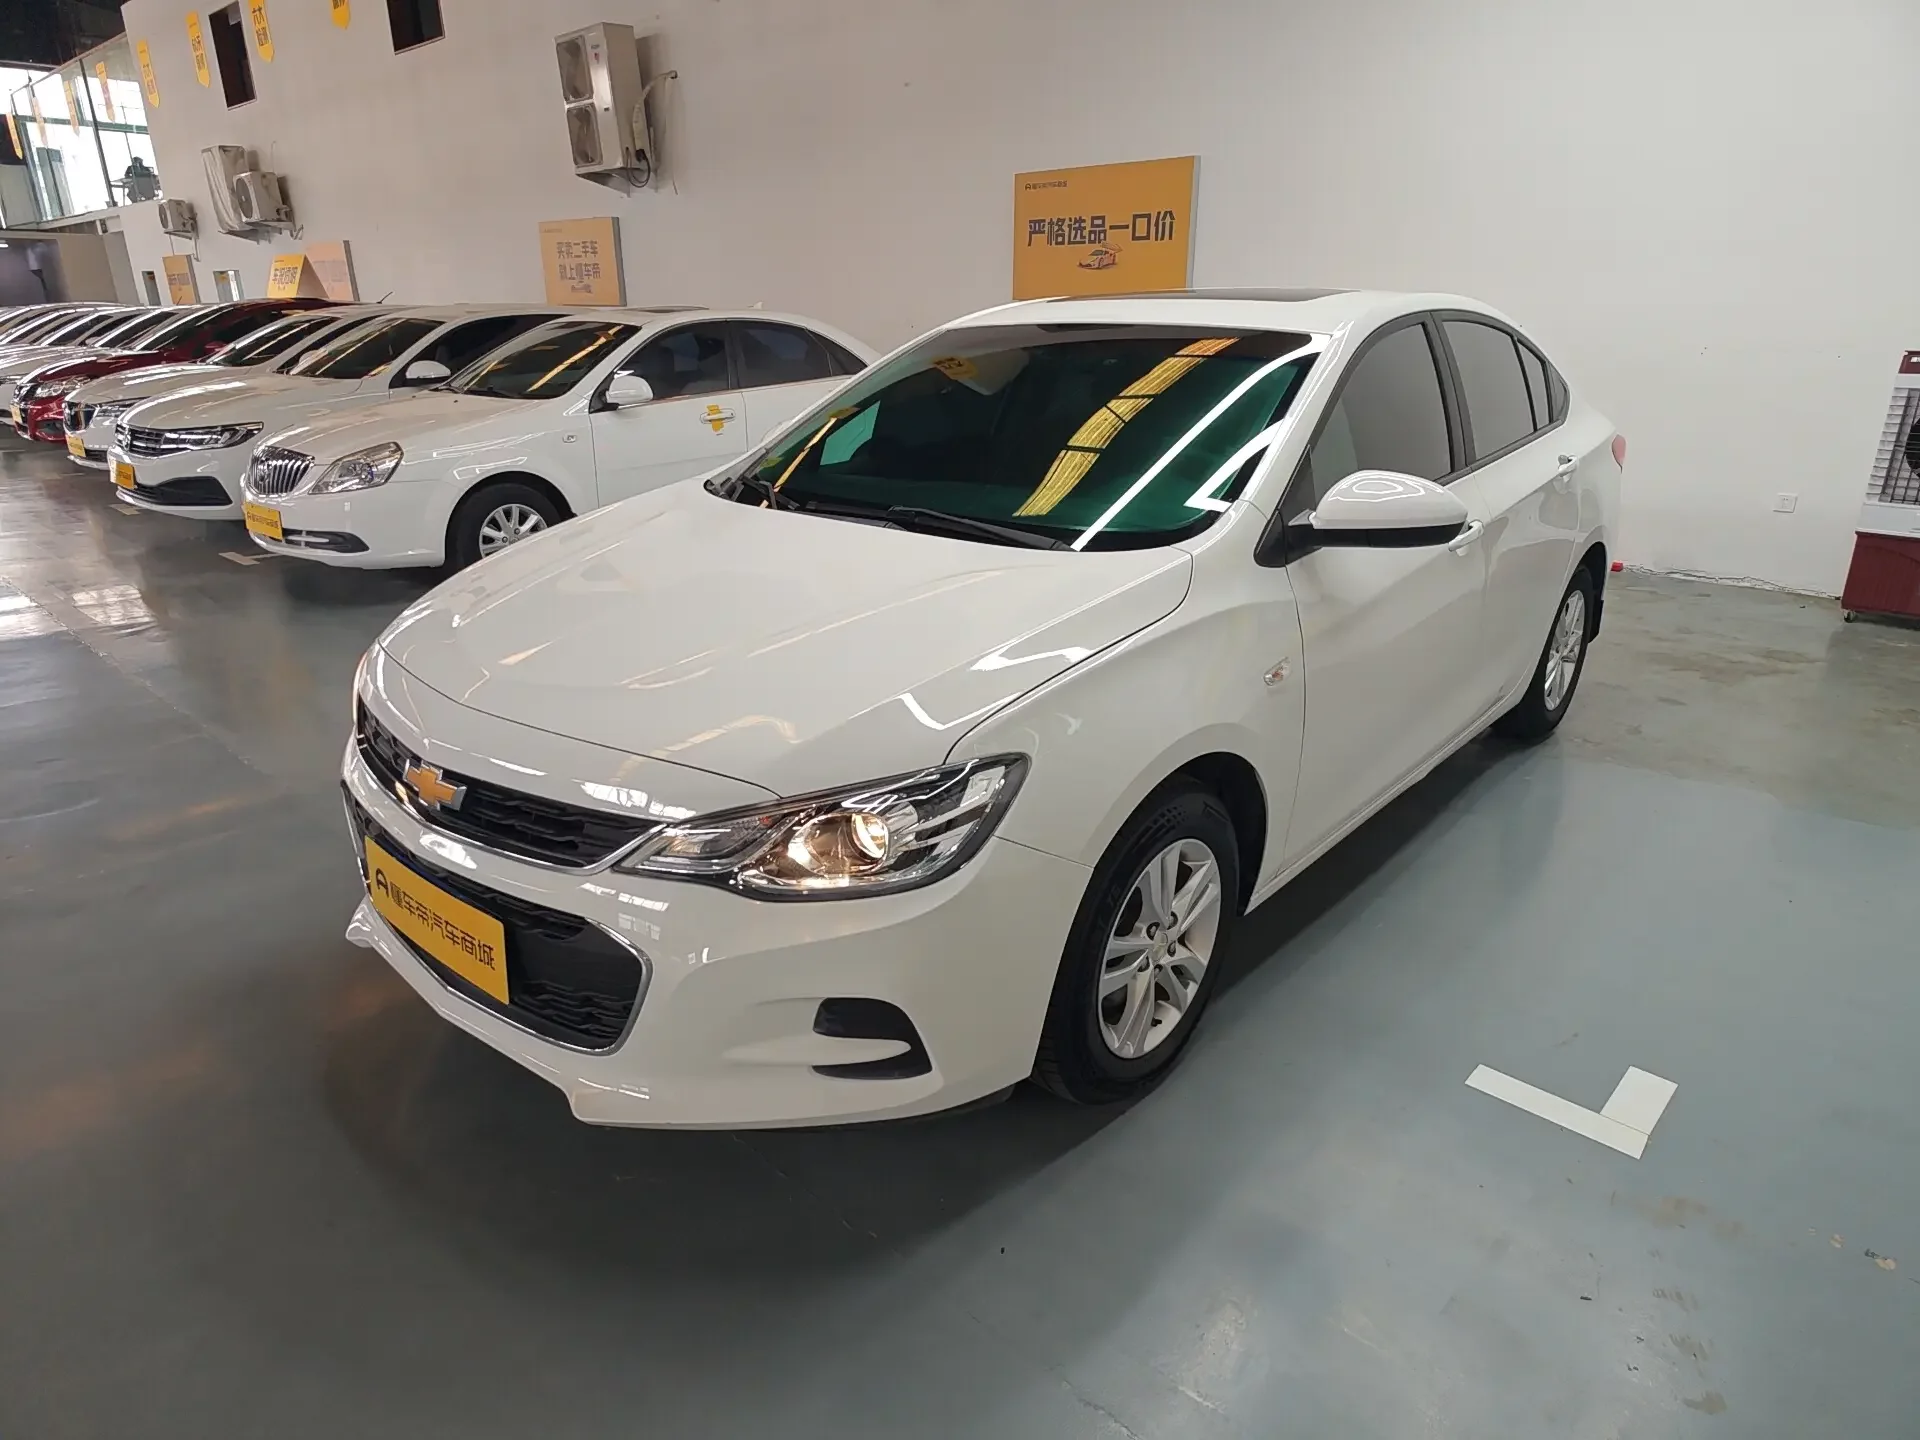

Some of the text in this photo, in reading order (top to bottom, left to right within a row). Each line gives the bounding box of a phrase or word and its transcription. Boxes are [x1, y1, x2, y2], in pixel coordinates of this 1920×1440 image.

[1027, 210, 1176, 247] 严格选品一口价
